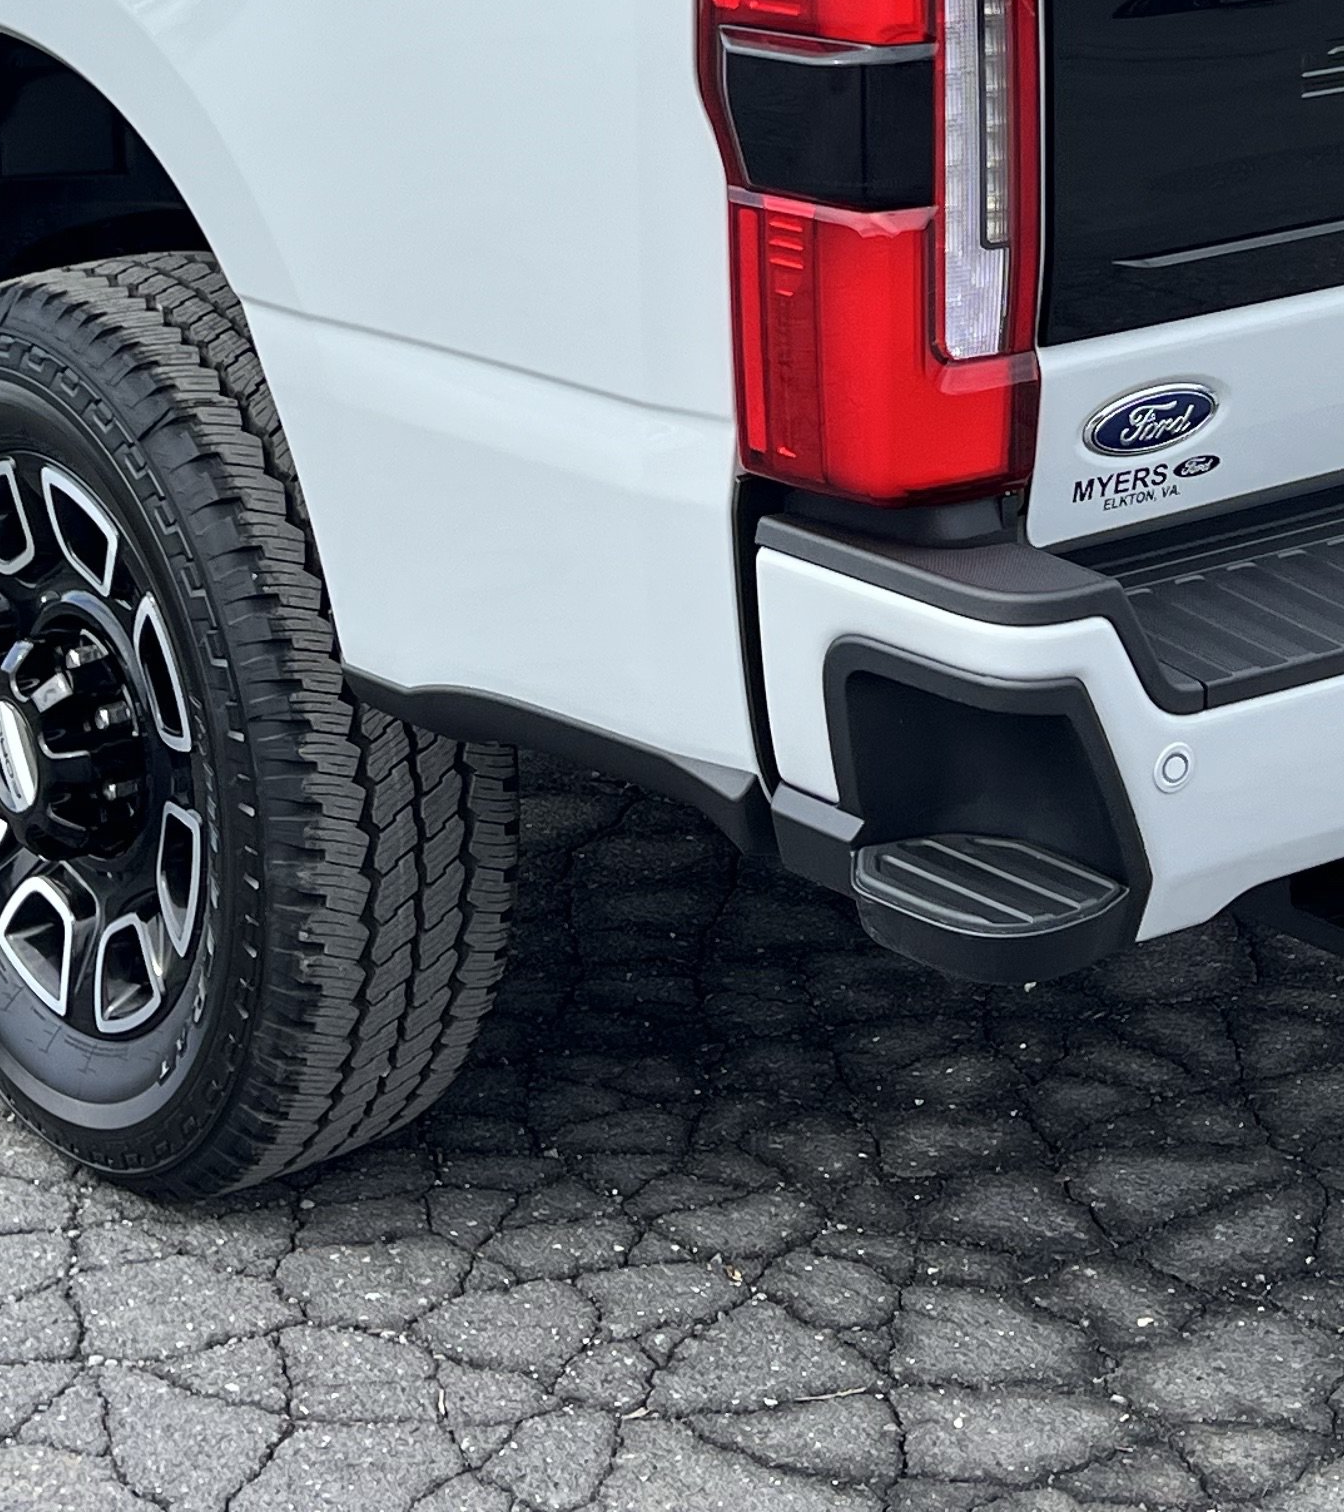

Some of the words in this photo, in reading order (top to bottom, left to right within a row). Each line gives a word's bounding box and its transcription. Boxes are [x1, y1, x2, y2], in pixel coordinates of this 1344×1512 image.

[1119, 400, 1196, 446] Ford
[1071, 462, 1169, 504] MYERS
[1179, 456, 1215, 477] Ford
[1102, 486, 1158, 512] ELKTON,
